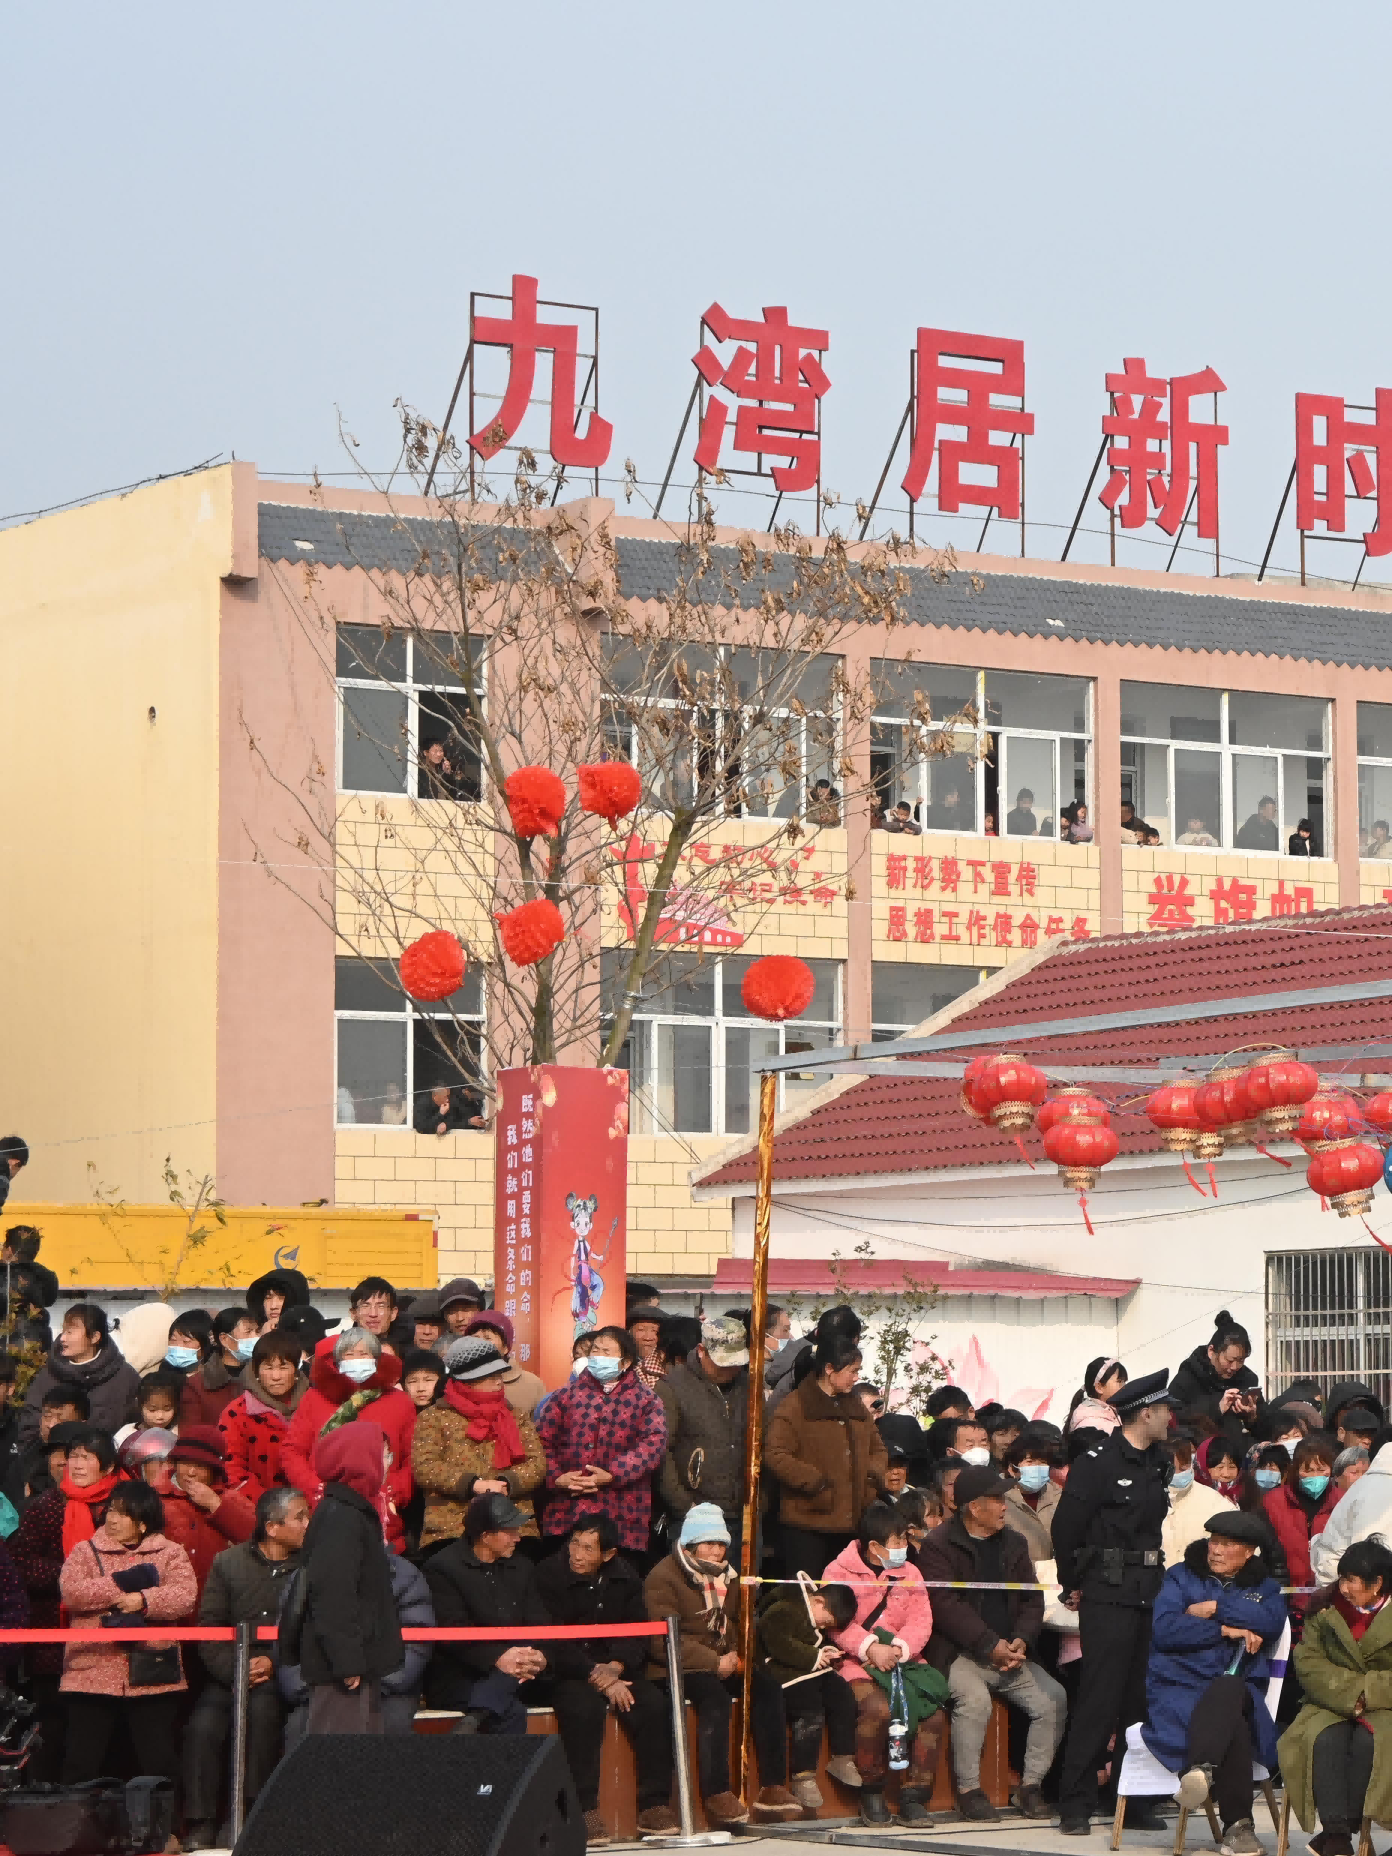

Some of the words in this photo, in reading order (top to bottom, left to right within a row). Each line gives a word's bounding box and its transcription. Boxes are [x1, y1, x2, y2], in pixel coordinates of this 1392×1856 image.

[886, 852, 1036, 897] 新形势下宣传
